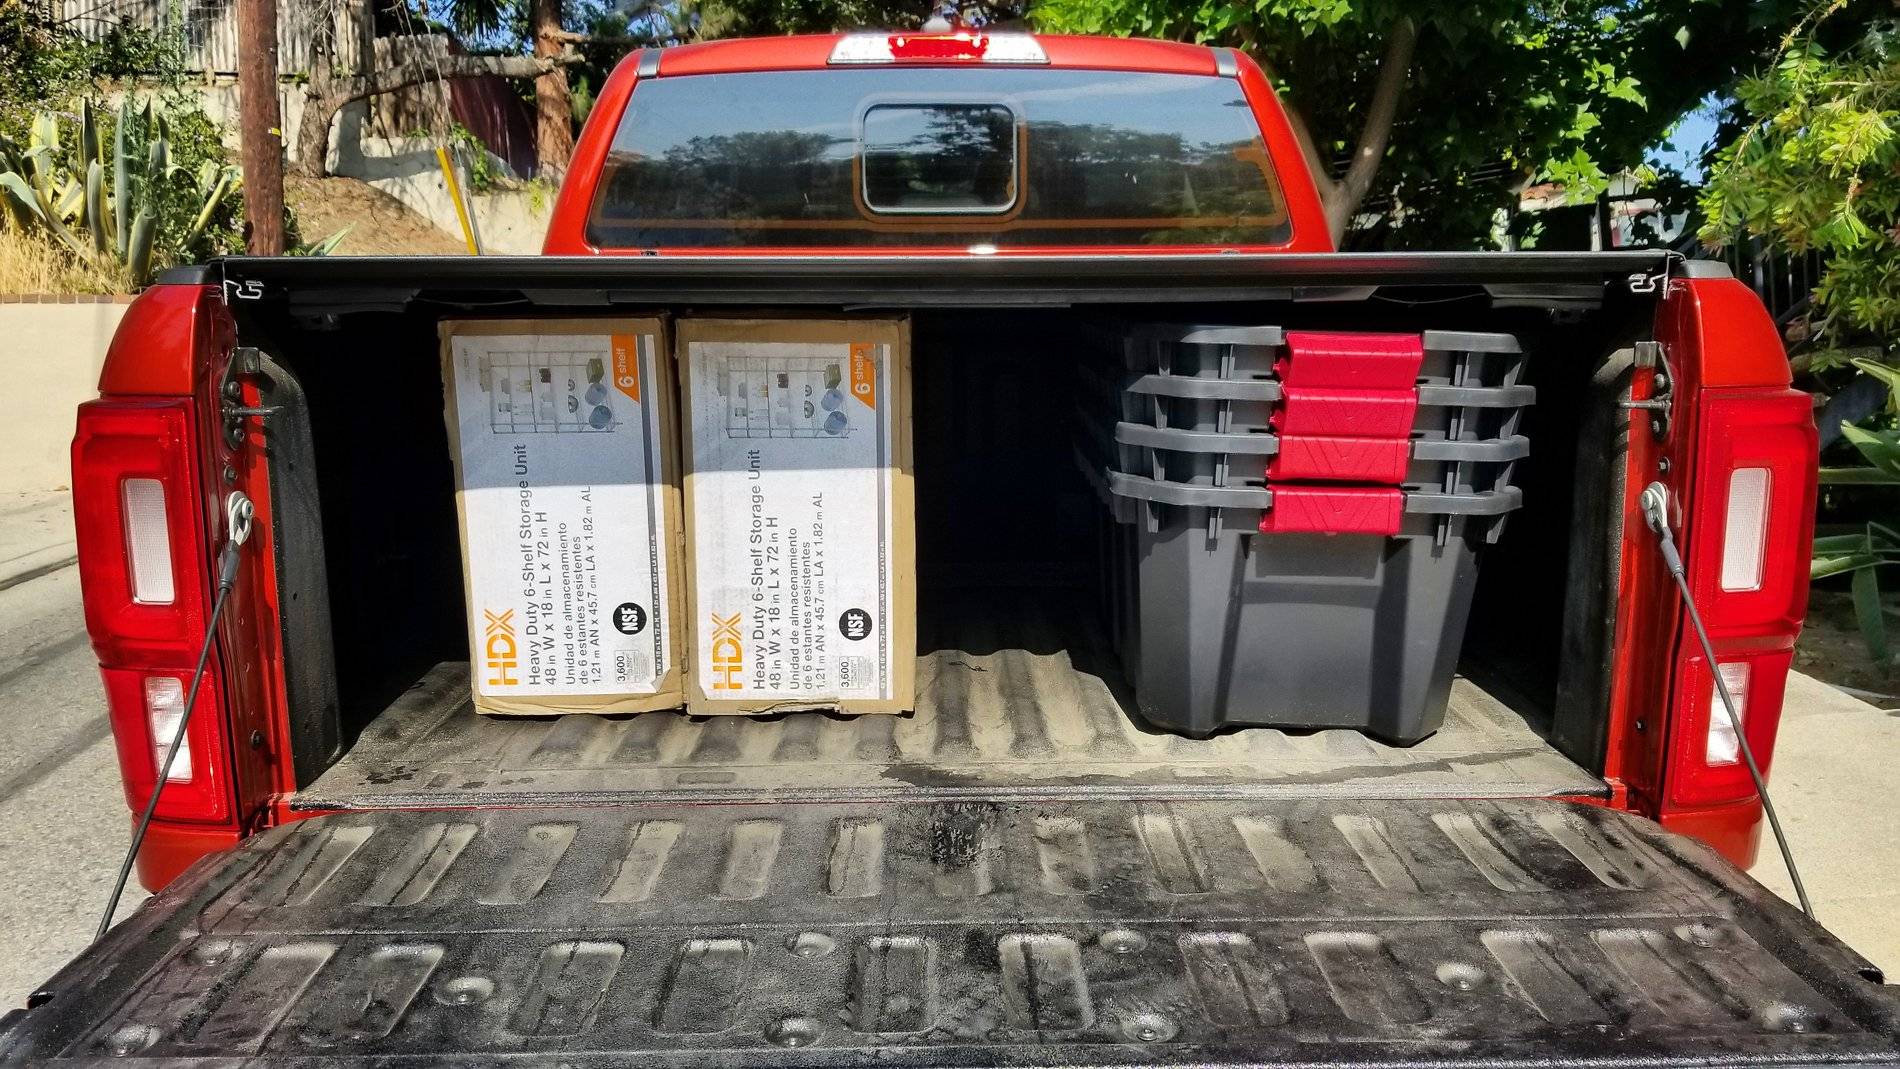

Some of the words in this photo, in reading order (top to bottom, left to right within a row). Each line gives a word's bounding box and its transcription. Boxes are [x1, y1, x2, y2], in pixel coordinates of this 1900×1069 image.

[616, 348, 626, 374] shelf
[618, 376, 634, 388] 6
[855, 383, 870, 394] 6
[513, 444, 528, 475] Unit
[747, 449, 760, 480] Unit
[581, 486, 591, 503] AL
[812, 492, 822, 508] AL
[519, 480, 532, 539] Storage
[535, 511, 547, 523] H
[585, 506, 592, 515] m
[750, 485, 764, 544] Storage
[816, 512, 822, 520] m
[583, 517, 594, 541] 1.82
[766, 517, 778, 528] H
[539, 527, 548, 538] in
[769, 532, 778, 543] in
[813, 522, 823, 546] 1.82
[537, 541, 549, 558] 72
[766, 546, 779, 563] 72
[520, 544, 536, 597] 6-Shelf
[541, 563, 550, 571] x
[558, 522, 573, 621] almacenamiento
[572, 536, 584, 602] resistentes
[585, 555, 596, 571] LA
[814, 560, 824, 577] LA
[540, 576, 551, 584] L
[750, 548, 764, 601] 6-Shelf
[770, 568, 779, 576] x
[788, 527, 799, 626] almacenamiento
[801, 541, 811, 607] resistentes
[590, 574, 597, 589] cm
[768, 580, 780, 589] L
[817, 580, 824, 595] cm
[543, 589, 552, 599] in
[771, 594, 780, 604] in
[541, 602, 553, 618] 18
[587, 591, 598, 616] 45.7
[815, 597, 825, 621] 45.7
[526, 601, 540, 635] Duty
[620, 607, 639, 631] NSF
[752, 606, 766, 640] Duty
[768, 607, 780, 623] 18
[545, 623, 554, 632] x
[564, 624, 574, 640] de
[576, 605, 587, 656] estantes
[771, 628, 780, 636] x
[847, 612, 864, 637] NSF
[542, 636, 555, 651] W
[589, 629, 600, 646] AN
[789, 629, 799, 645] de
[803, 611, 812, 662] estantes
[815, 634, 825, 652] AN
[484, 608, 518, 685] HDX
[594, 650, 600, 659] m
[711, 612, 743, 690] HDX
[768, 640, 781, 655] W
[528, 640, 541, 685] Heavy
[546, 655, 556, 665] in
[564, 643, 576, 685] Unidad
[772, 659, 781, 670] in
[819, 654, 825, 663] m
[591, 662, 601, 684] 1.21
[616, 655, 628, 682] 3,600
[753, 645, 767, 690] Heavy
[789, 648, 800, 690] Unidad
[803, 664, 812, 672] 6
[840, 661, 850, 688] 3,600
[545, 668, 557, 685] 48
[579, 669, 588, 685] de
[769, 673, 781, 690] 48
[803, 674, 813, 690] de
[815, 667, 826, 689] 1.21
